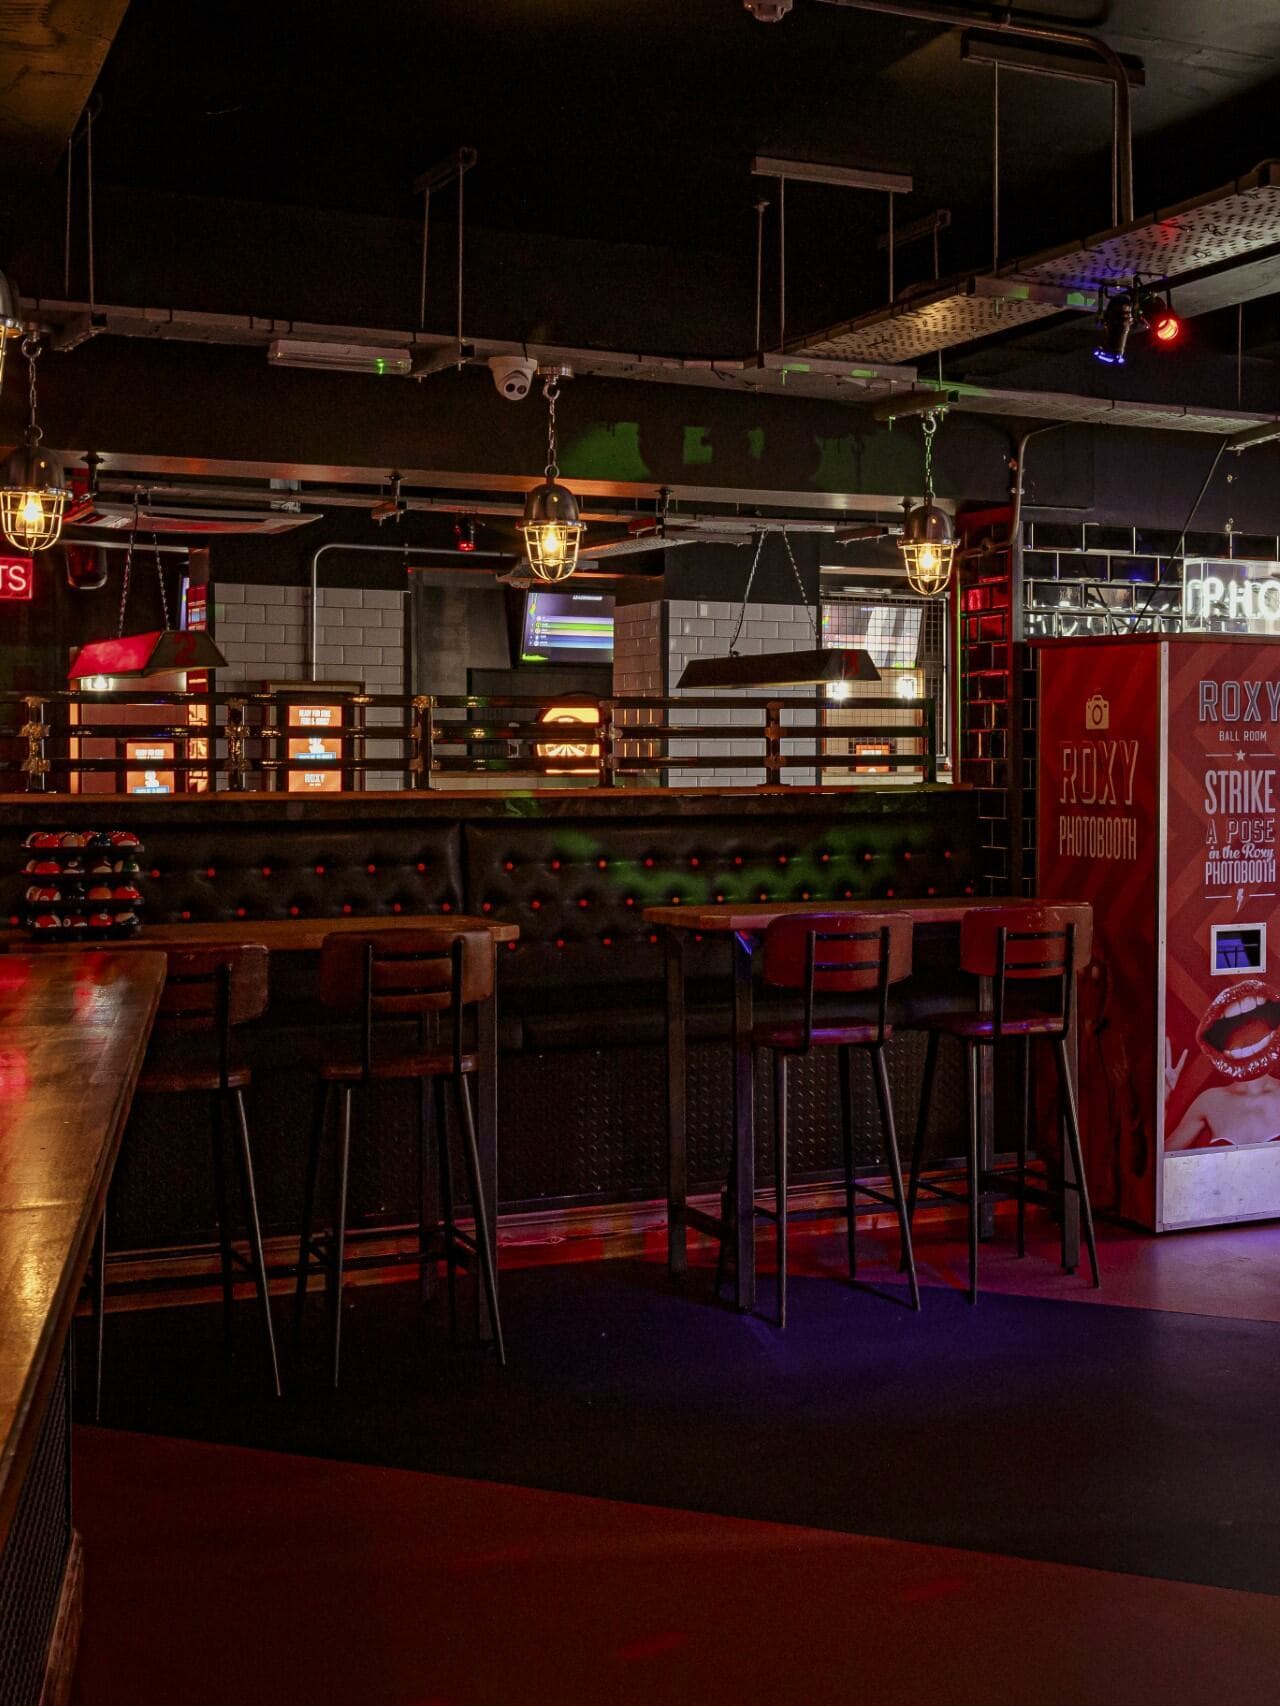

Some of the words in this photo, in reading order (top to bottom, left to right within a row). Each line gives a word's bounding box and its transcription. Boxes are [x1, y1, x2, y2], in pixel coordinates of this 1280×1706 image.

[1219, 730, 1240, 741] BALL
[1243, 730, 1267, 741] ROOM
[1059, 739, 1139, 805] ROXY
[1204, 769, 1276, 815] STRIKE
[1059, 815, 1137, 861] PHOTOBOOTH
[1205, 819, 1218, 844] A
[1226, 818, 1276, 844] POSE
[1208, 845, 1221, 860] in
[1222, 845, 1241, 859] the
[1241, 843, 1275, 863] Roxy
[1205, 860, 1276, 885] PHOTOBOOTH
